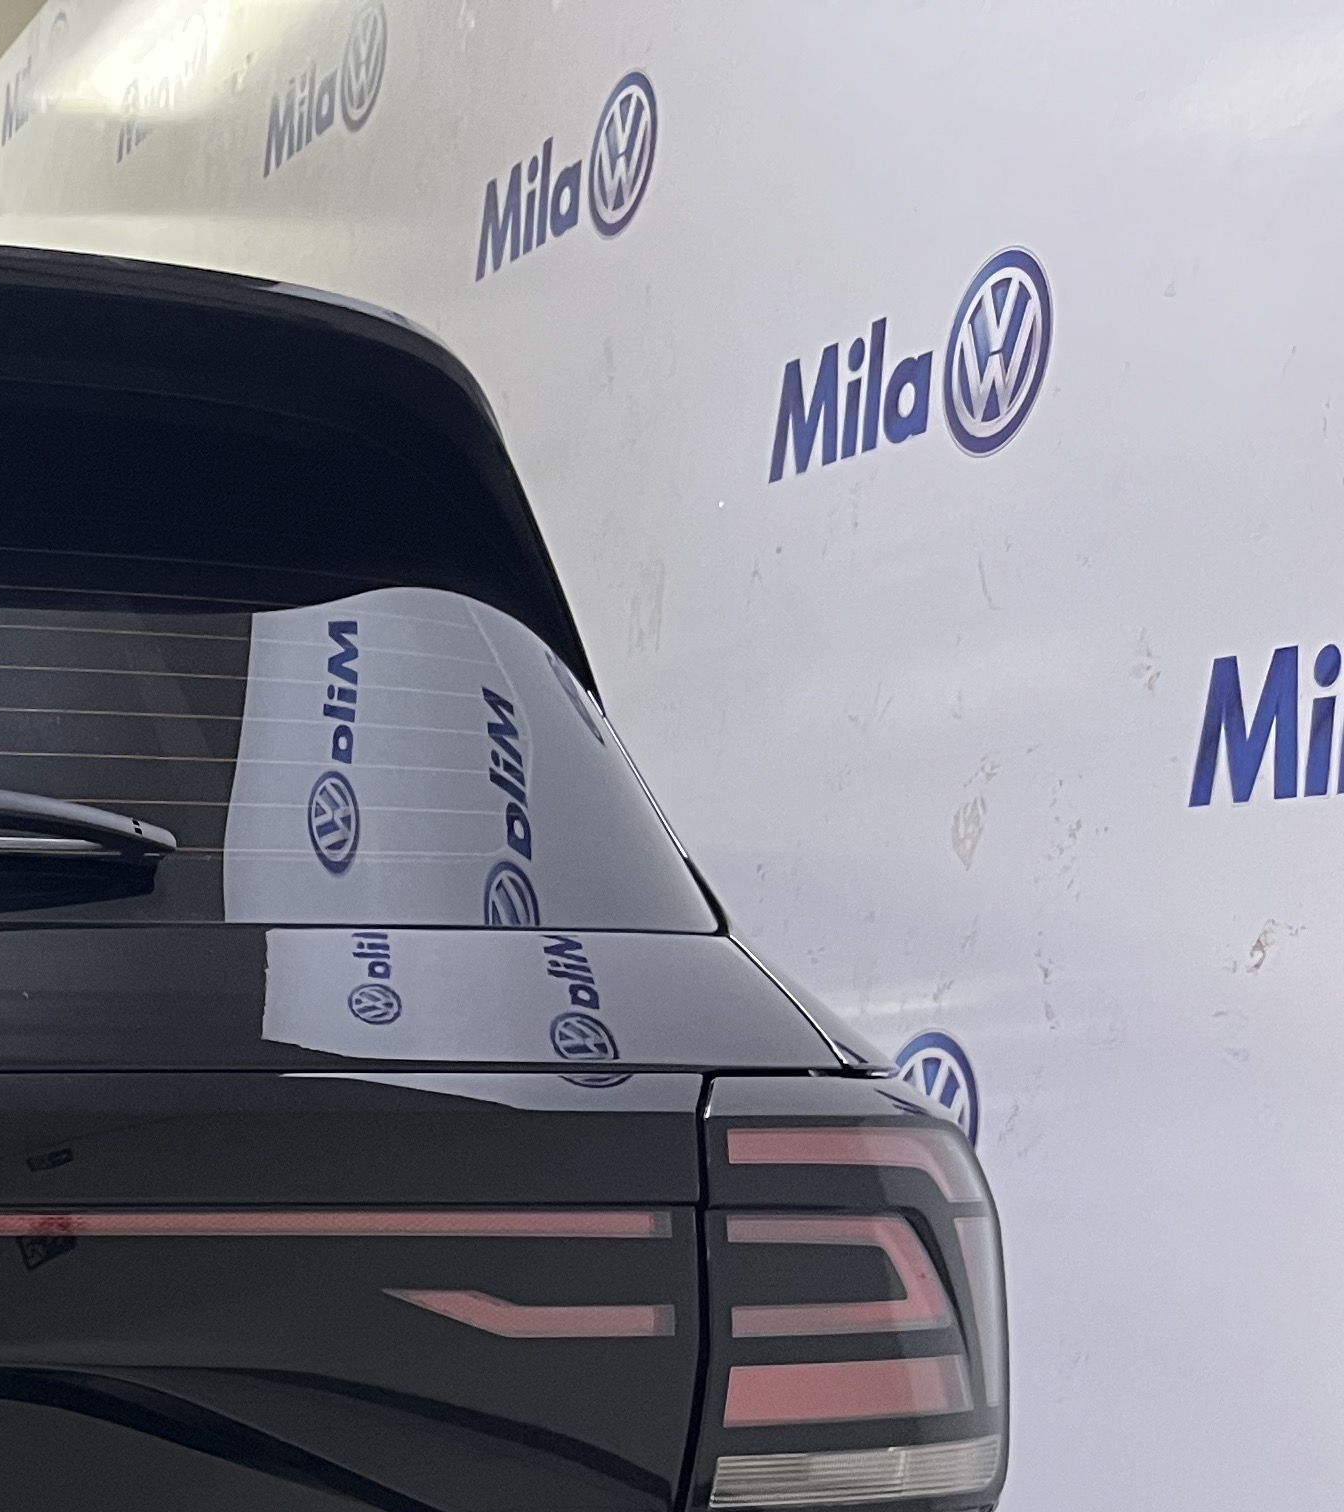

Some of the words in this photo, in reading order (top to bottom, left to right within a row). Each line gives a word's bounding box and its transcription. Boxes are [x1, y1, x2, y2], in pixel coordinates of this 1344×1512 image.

[263, 64, 339, 179] Mila
[475, 136, 582, 283] Mila
[768, 316, 933, 484] Mila
[1188, 643, 1344, 808] Mi
